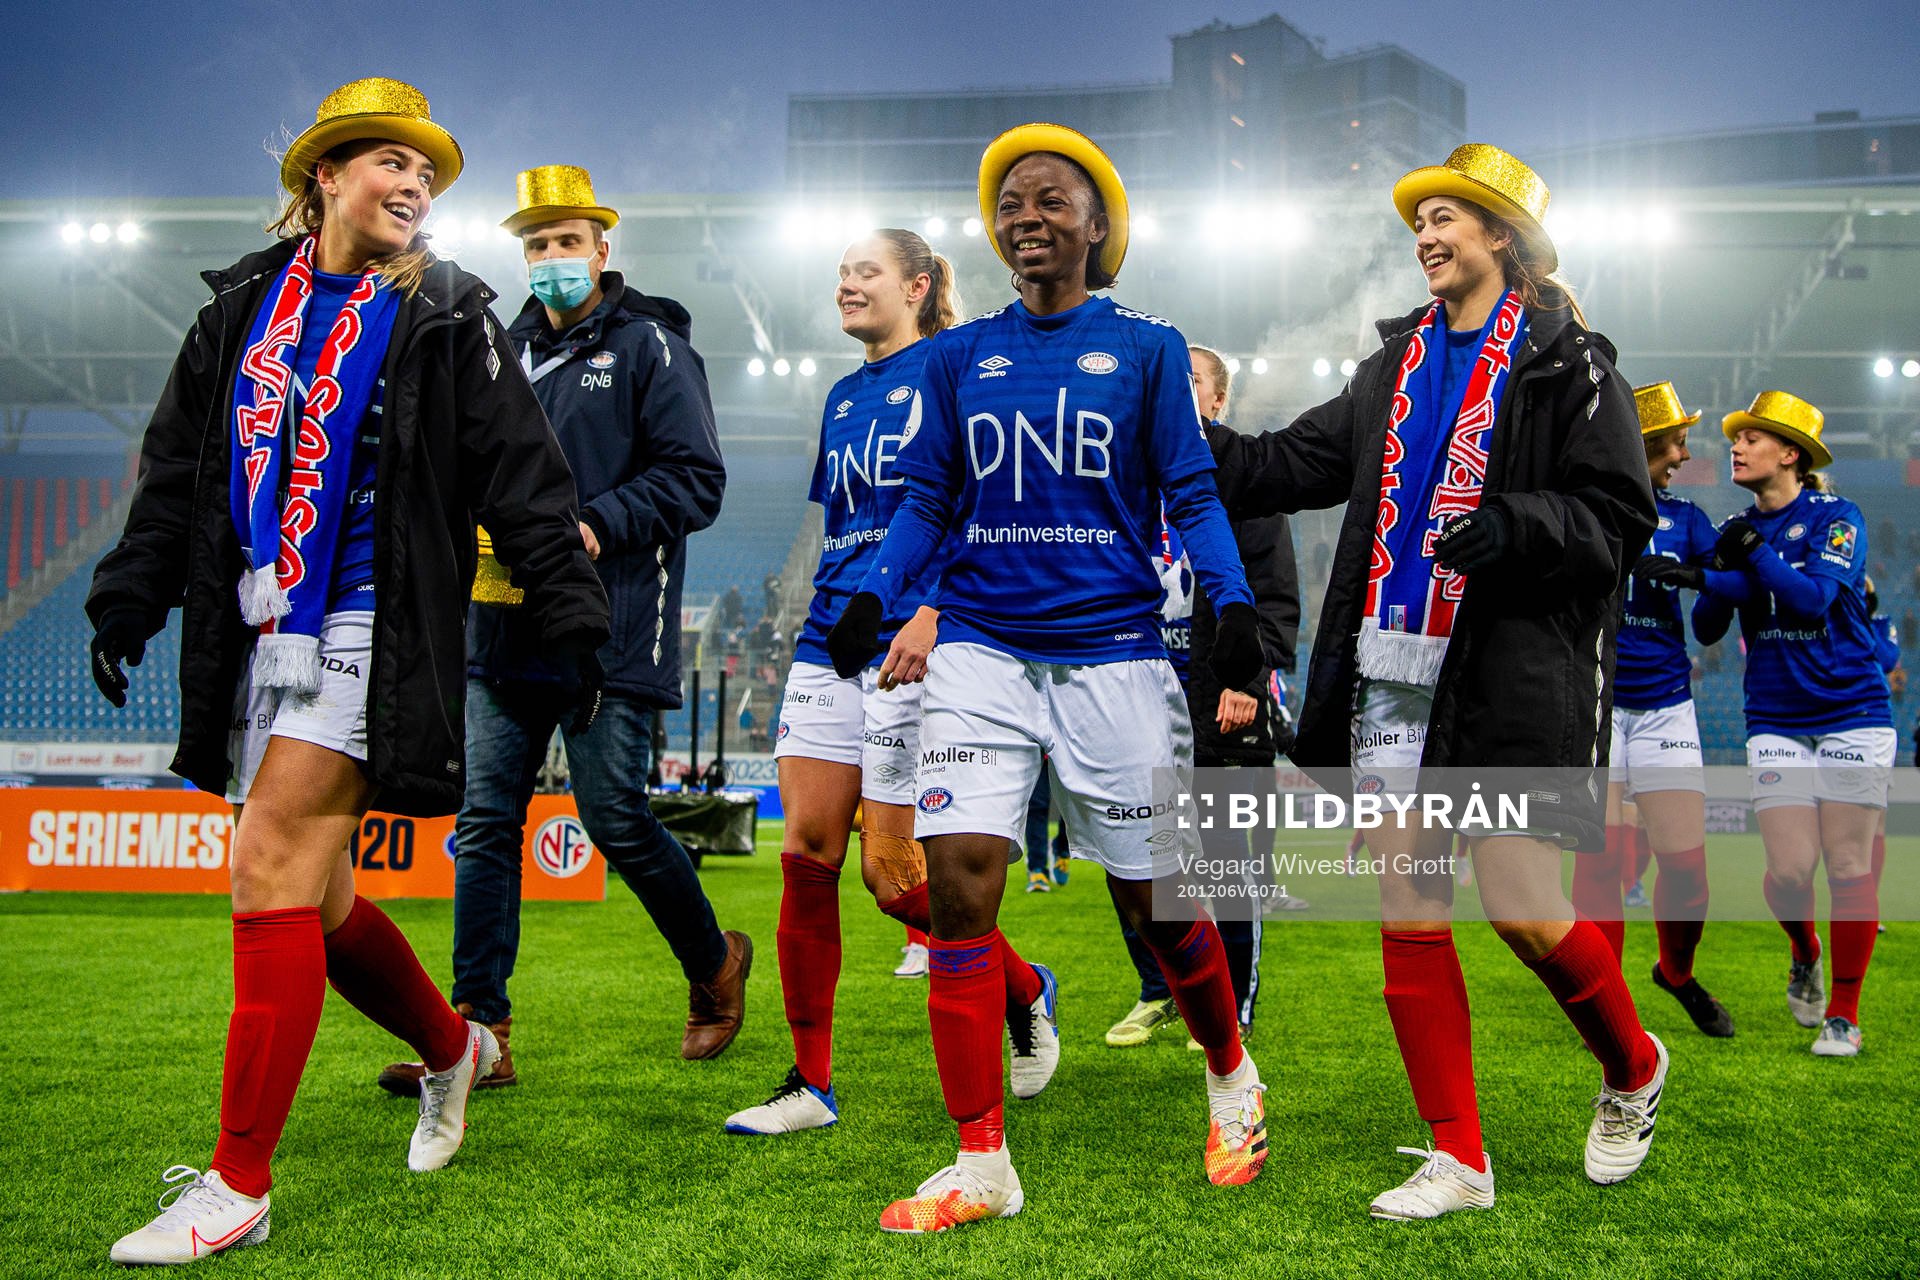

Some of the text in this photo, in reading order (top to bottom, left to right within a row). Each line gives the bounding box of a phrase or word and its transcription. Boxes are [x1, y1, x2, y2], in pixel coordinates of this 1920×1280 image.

[581, 371, 612, 391] DNB
[979, 370, 1006, 379] umbro
[968, 388, 1114, 502] DNB
[966, 523, 1117, 545] #huninvesterer
[981, 749, 997, 766] Bil
